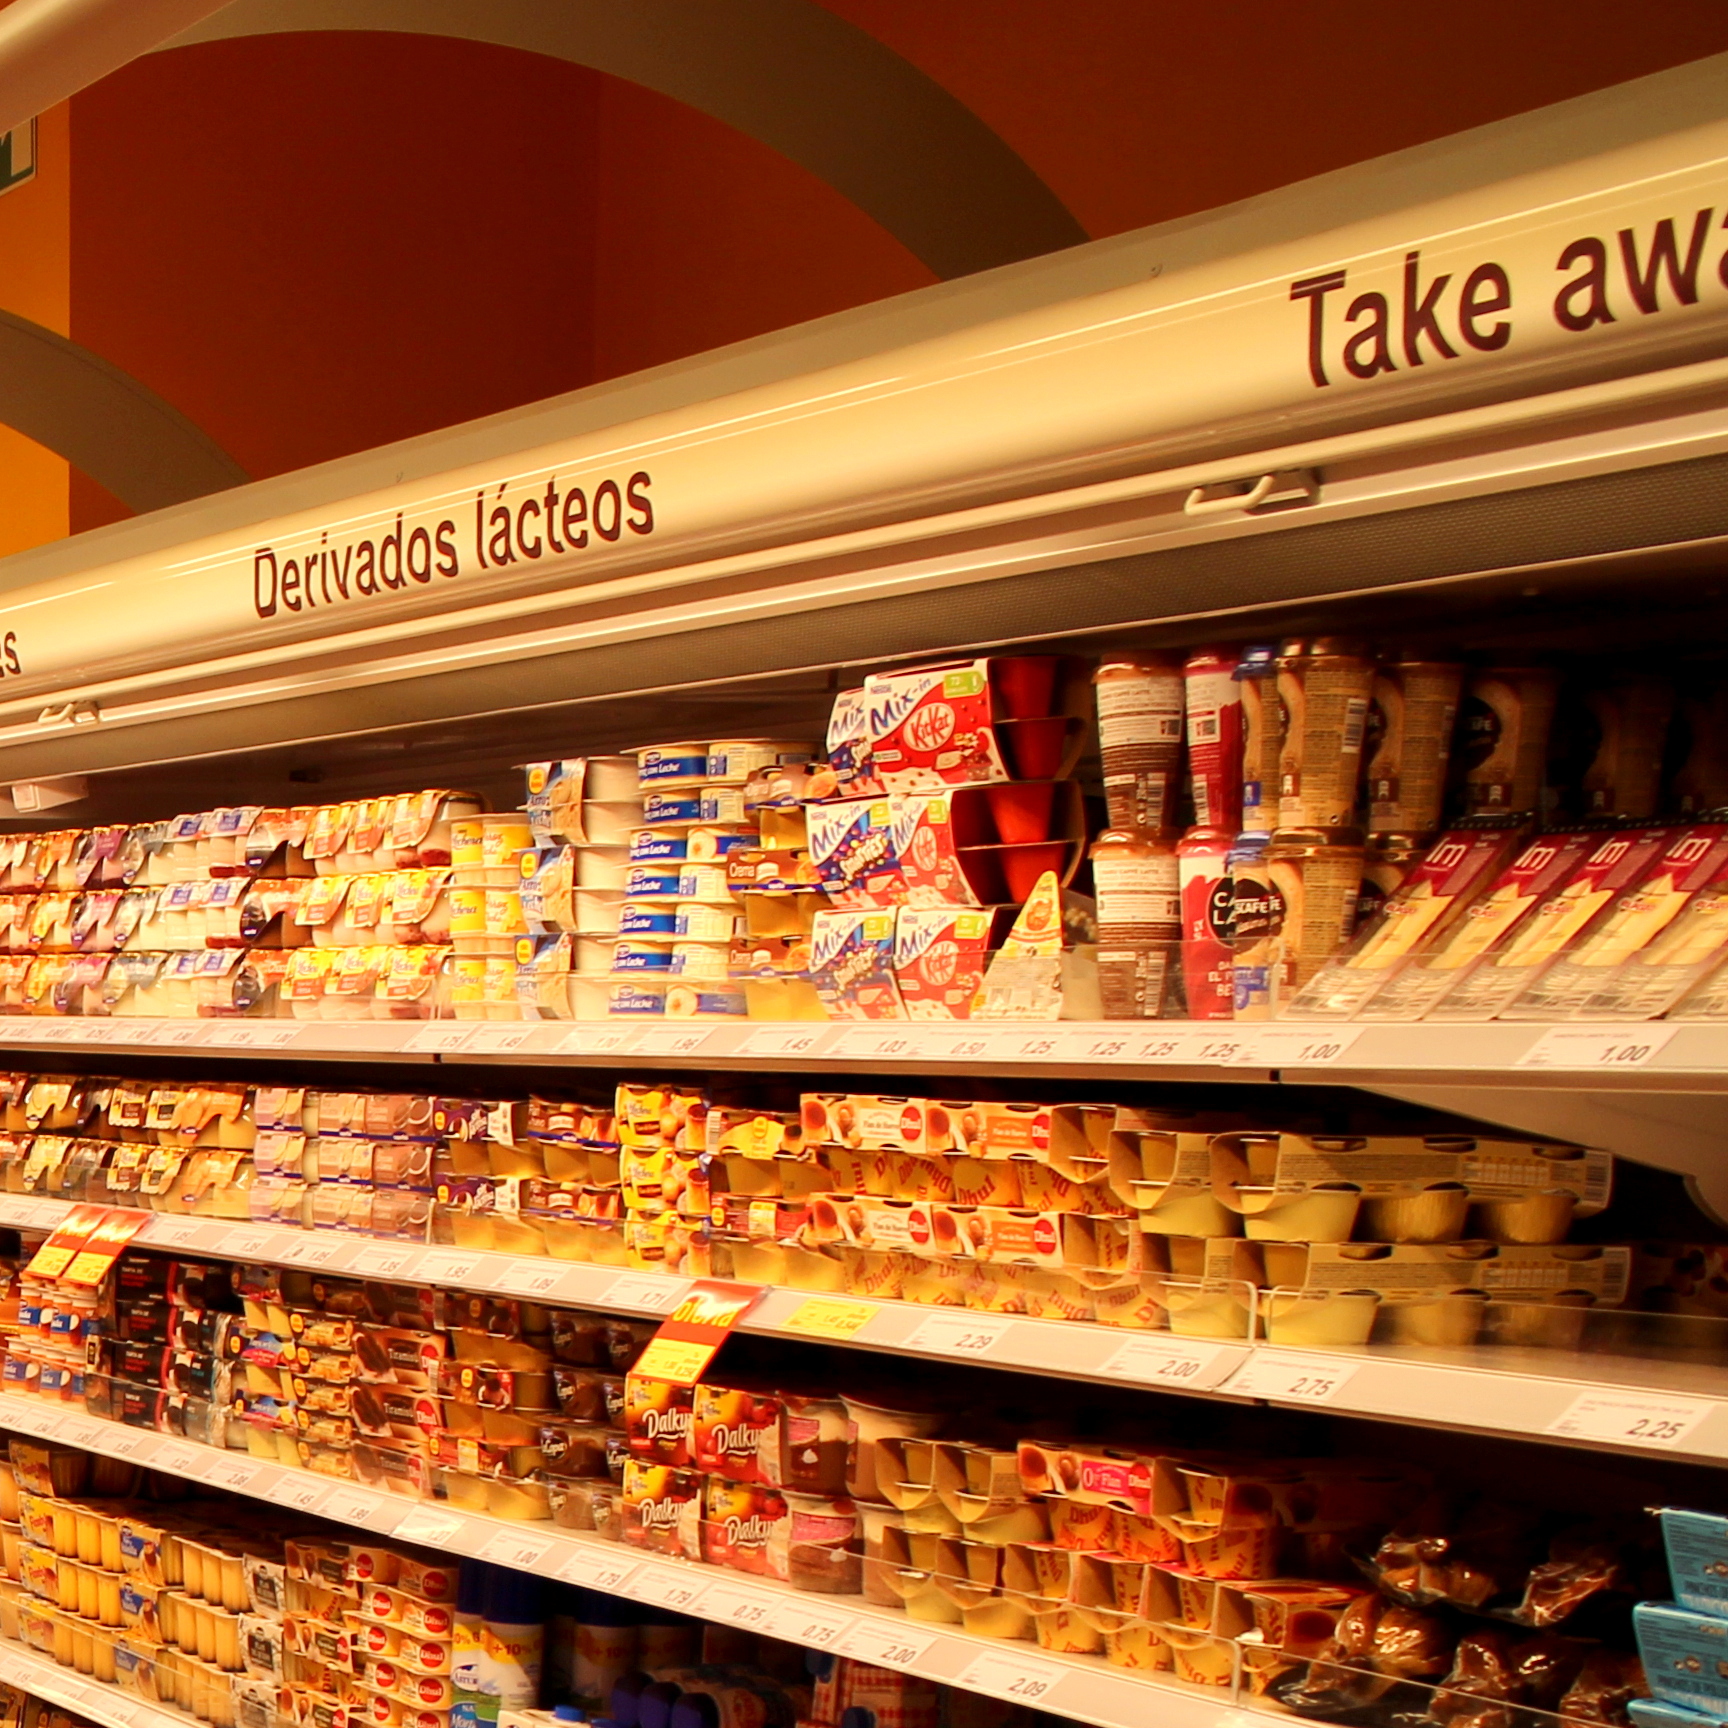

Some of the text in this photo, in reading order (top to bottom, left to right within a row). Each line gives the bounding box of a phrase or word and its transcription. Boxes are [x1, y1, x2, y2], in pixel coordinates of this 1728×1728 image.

[1290, 251, 1513, 387] Take
[253, 470, 655, 619] Derivados lácteos
[910, 707, 949, 748] KitKat
[1019, 1040, 1051, 1055] 1,25
[1088, 1040, 1122, 1056] 1,25
[1141, 1040, 1175, 1056] 1,25
[1198, 1042, 1240, 1059] 1,25
[1298, 1043, 1342, 1059] 1,00
[1598, 1045, 1651, 1062] 1,00
[954, 1333, 993, 1351] 2,29
[1156, 1359, 1201, 1378] 2,00
[1288, 1376, 1335, 1397] 2,75
[648, 1407, 694, 1439] Dalky
[1626, 1419, 1685, 1440] 2,25
[717, 1421, 764, 1455] Dalky
[640, 1492, 687, 1528] Dalky
[727, 1517, 778, 1546] Dalky
[802, 1624, 835, 1642] 0,75
[881, 1645, 917, 1663] 2,00
[1008, 1678, 1049, 1697] 2,09
